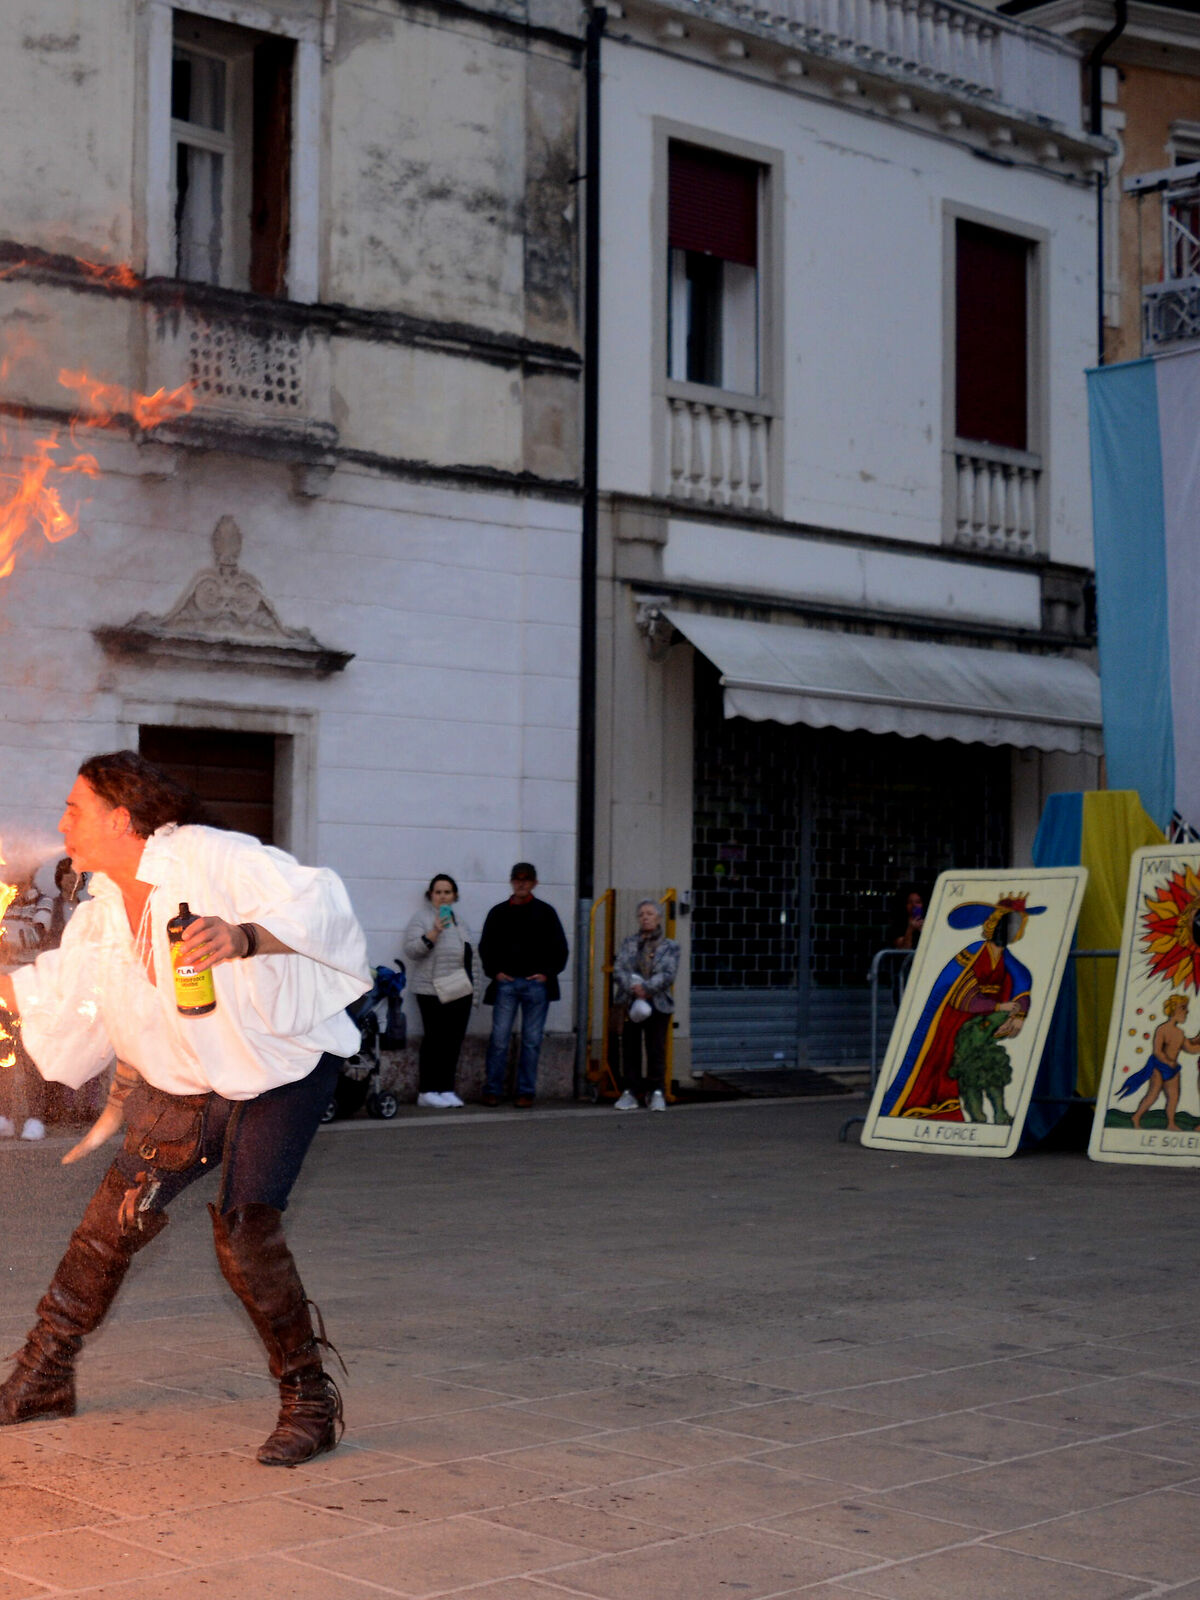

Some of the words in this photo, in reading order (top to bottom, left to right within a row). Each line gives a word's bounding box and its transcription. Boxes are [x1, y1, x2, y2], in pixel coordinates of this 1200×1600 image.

[913, 1125, 930, 1139] LA
[935, 1126, 978, 1141] FORCE
[1140, 1135, 1158, 1148] LE
